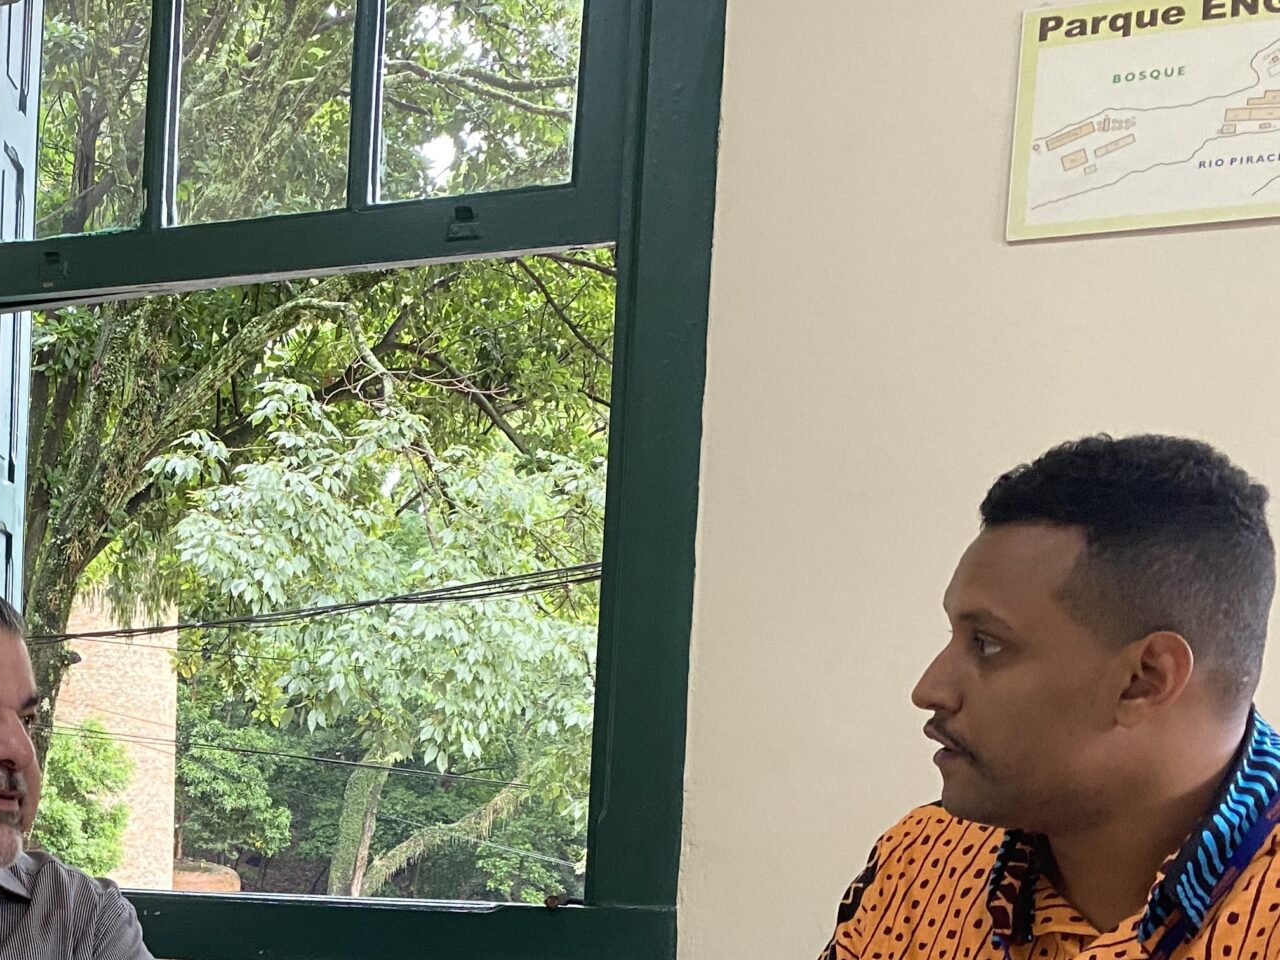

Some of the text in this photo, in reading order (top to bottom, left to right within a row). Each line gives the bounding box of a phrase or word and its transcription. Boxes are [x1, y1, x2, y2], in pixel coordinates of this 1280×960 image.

[1038, 5, 1186, 42] Parque
[1112, 66, 1186, 84] BOSQUE
[1199, 159, 1224, 168] RIO
